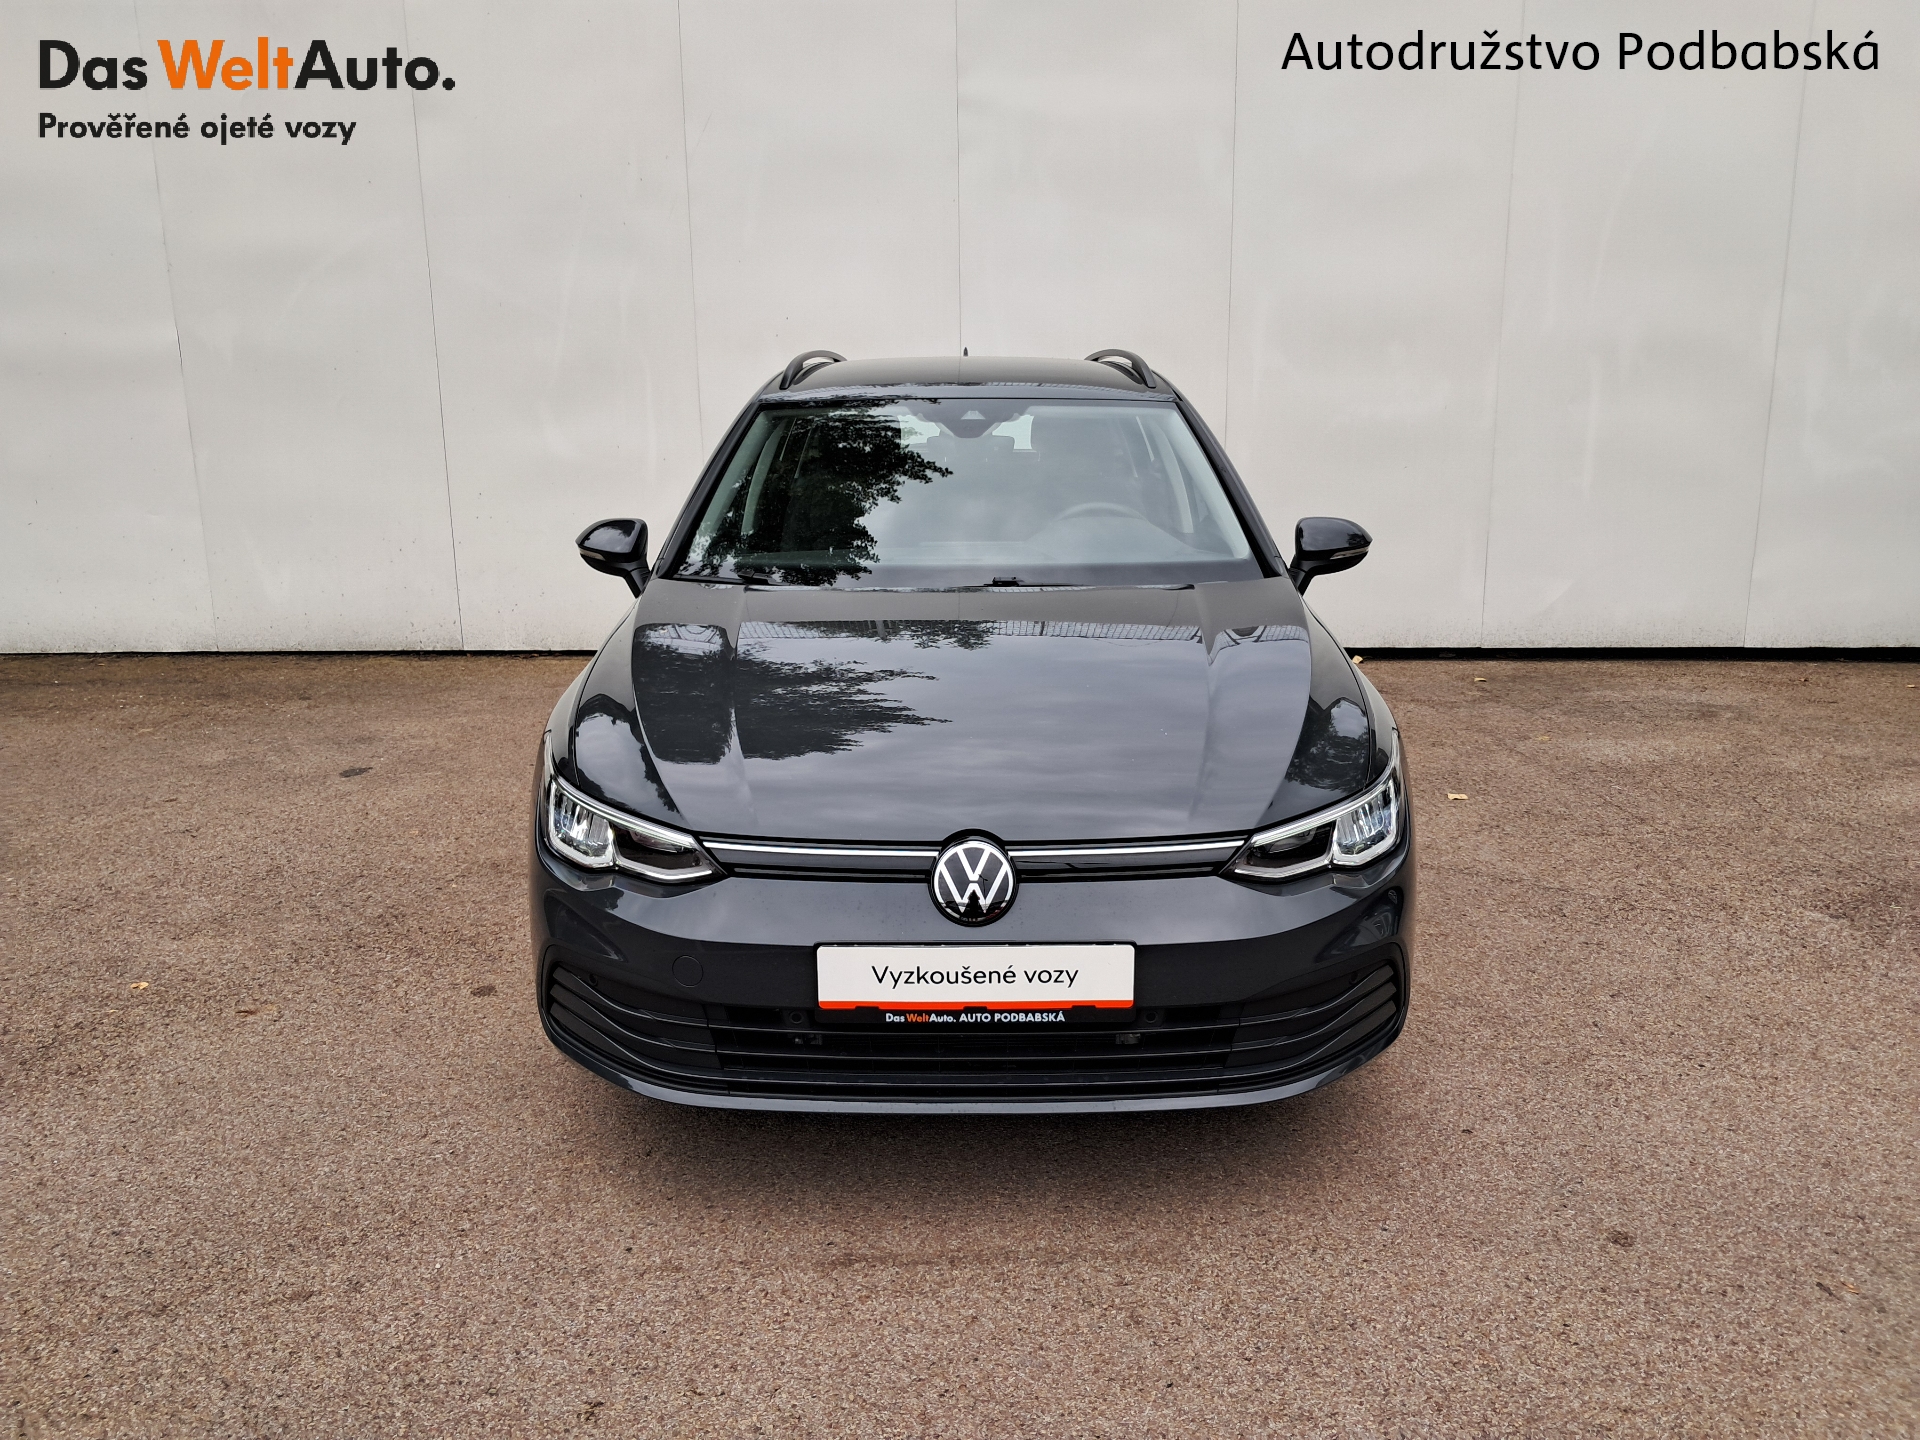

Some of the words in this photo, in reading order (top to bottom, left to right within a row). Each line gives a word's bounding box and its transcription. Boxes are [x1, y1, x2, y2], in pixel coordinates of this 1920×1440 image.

[871, 964, 1017, 990] Vyzkoušené
[1023, 968, 1079, 989] vozy
[885, 1012, 905, 1023] Das
[906, 1012, 957, 1023] WeltAuto.
[958, 1012, 992, 1023] AUTO
[994, 1010, 1066, 1023] PODBABSKÁ
